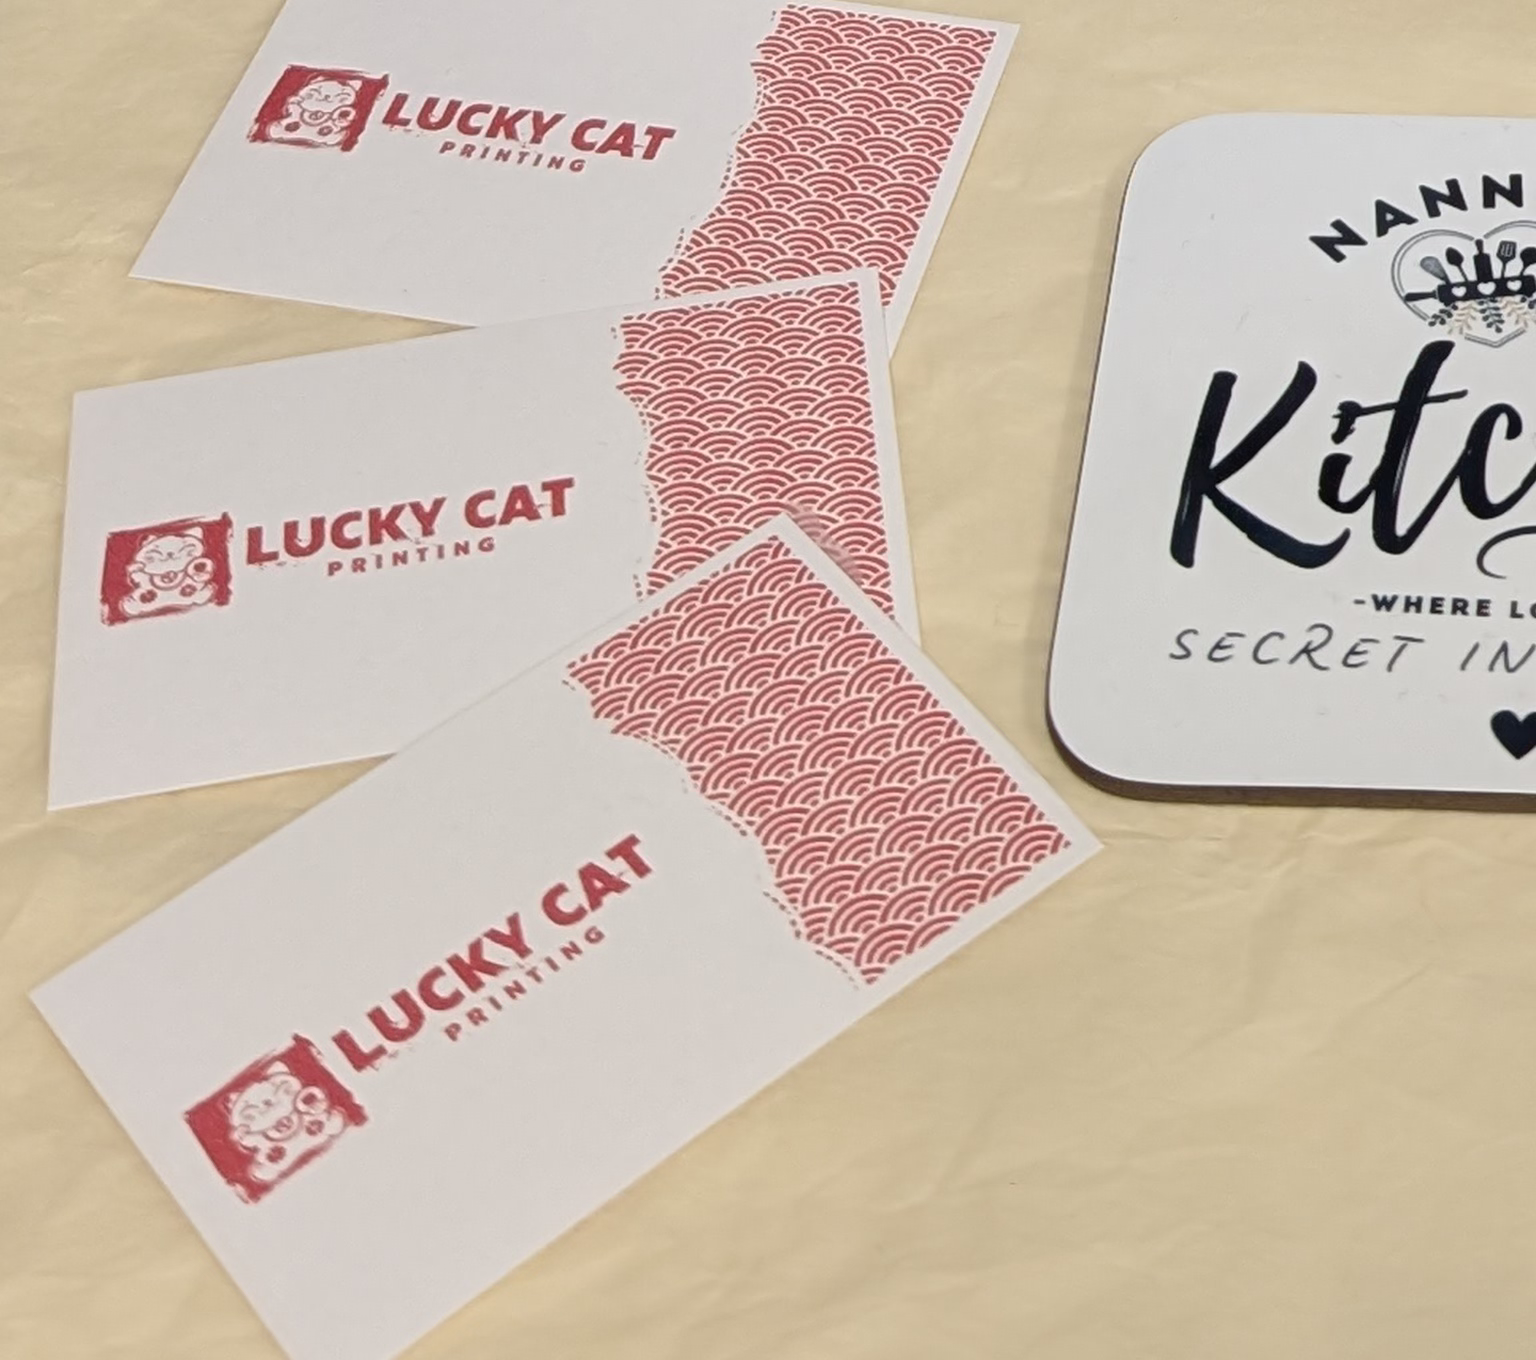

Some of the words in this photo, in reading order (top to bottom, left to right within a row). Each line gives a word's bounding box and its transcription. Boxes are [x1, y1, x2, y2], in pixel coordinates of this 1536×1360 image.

[382, 91, 567, 149] LUCKY
[570, 118, 677, 161] CAT
[439, 139, 587, 173] PRINTING
[245, 496, 447, 566] LUCKY
[463, 477, 575, 530] CAT
[327, 536, 497, 577] PRINTING
[1169, 623, 1425, 673] SECRET
[330, 912, 534, 1073] LUCKY
[540, 833, 655, 927] CAT
[443, 925, 607, 1042] PRINTING
